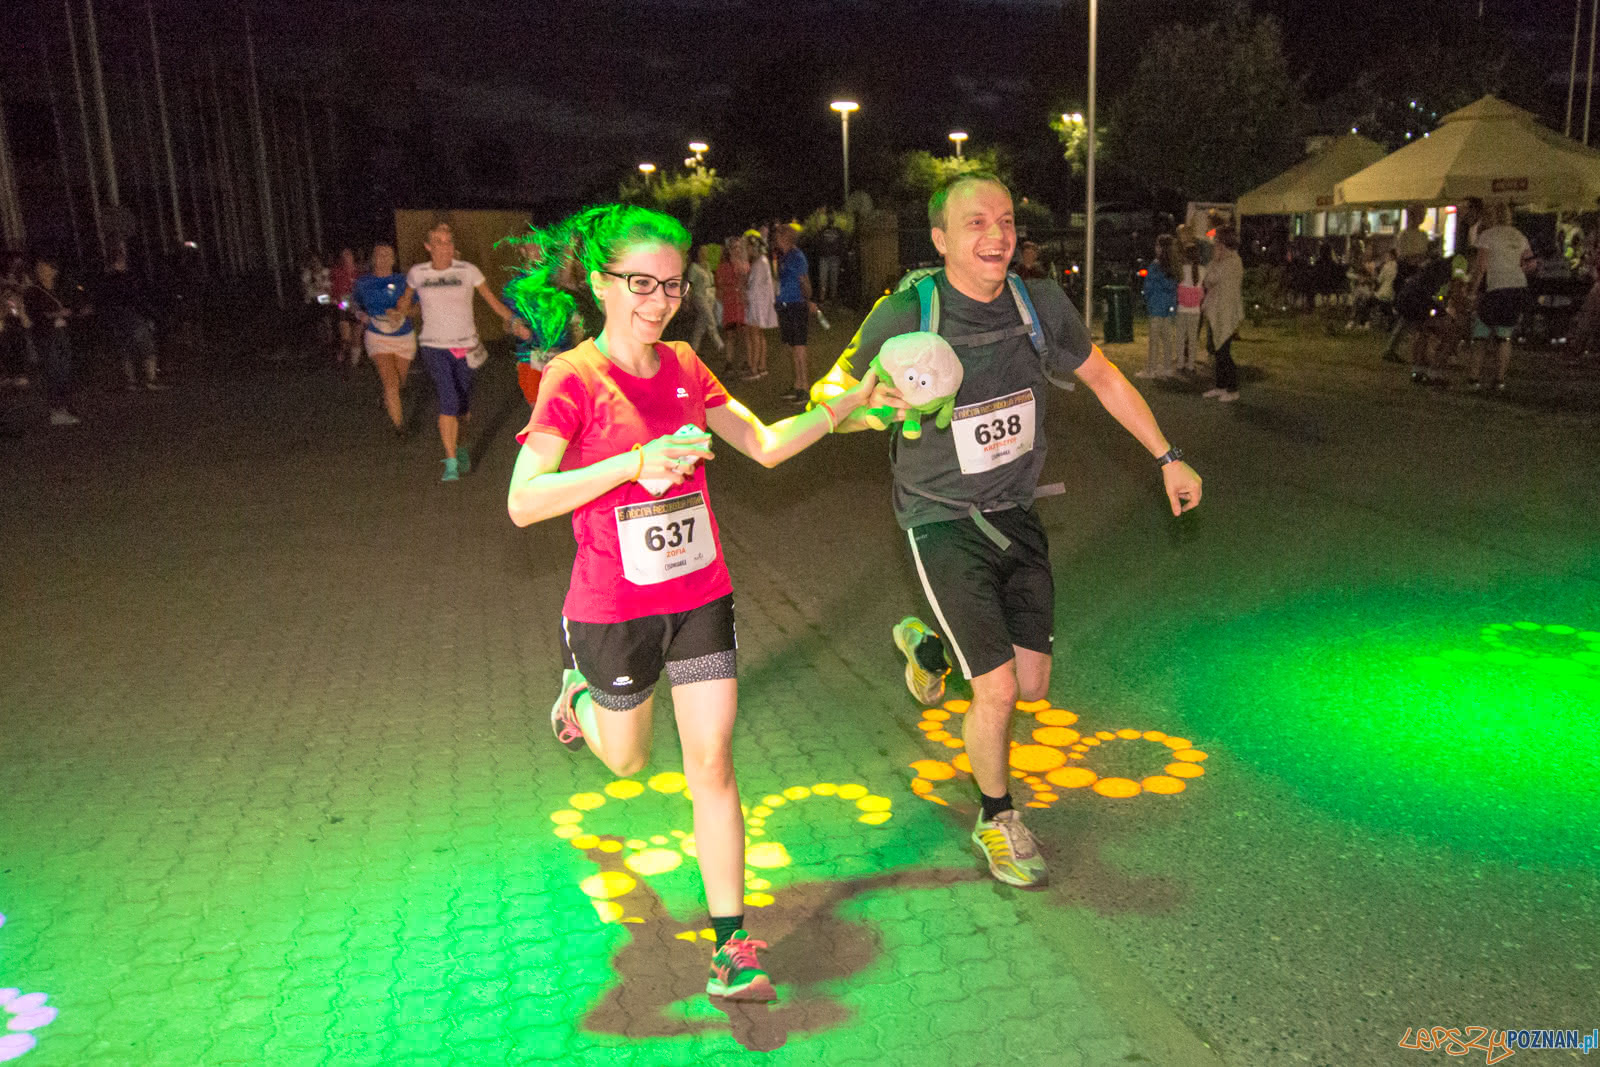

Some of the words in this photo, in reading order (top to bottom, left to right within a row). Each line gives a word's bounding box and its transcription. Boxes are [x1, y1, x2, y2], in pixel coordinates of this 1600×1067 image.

[974, 414, 1022, 445] 638
[644, 517, 695, 552] 637
[666, 547, 687, 558] ZOFIA
